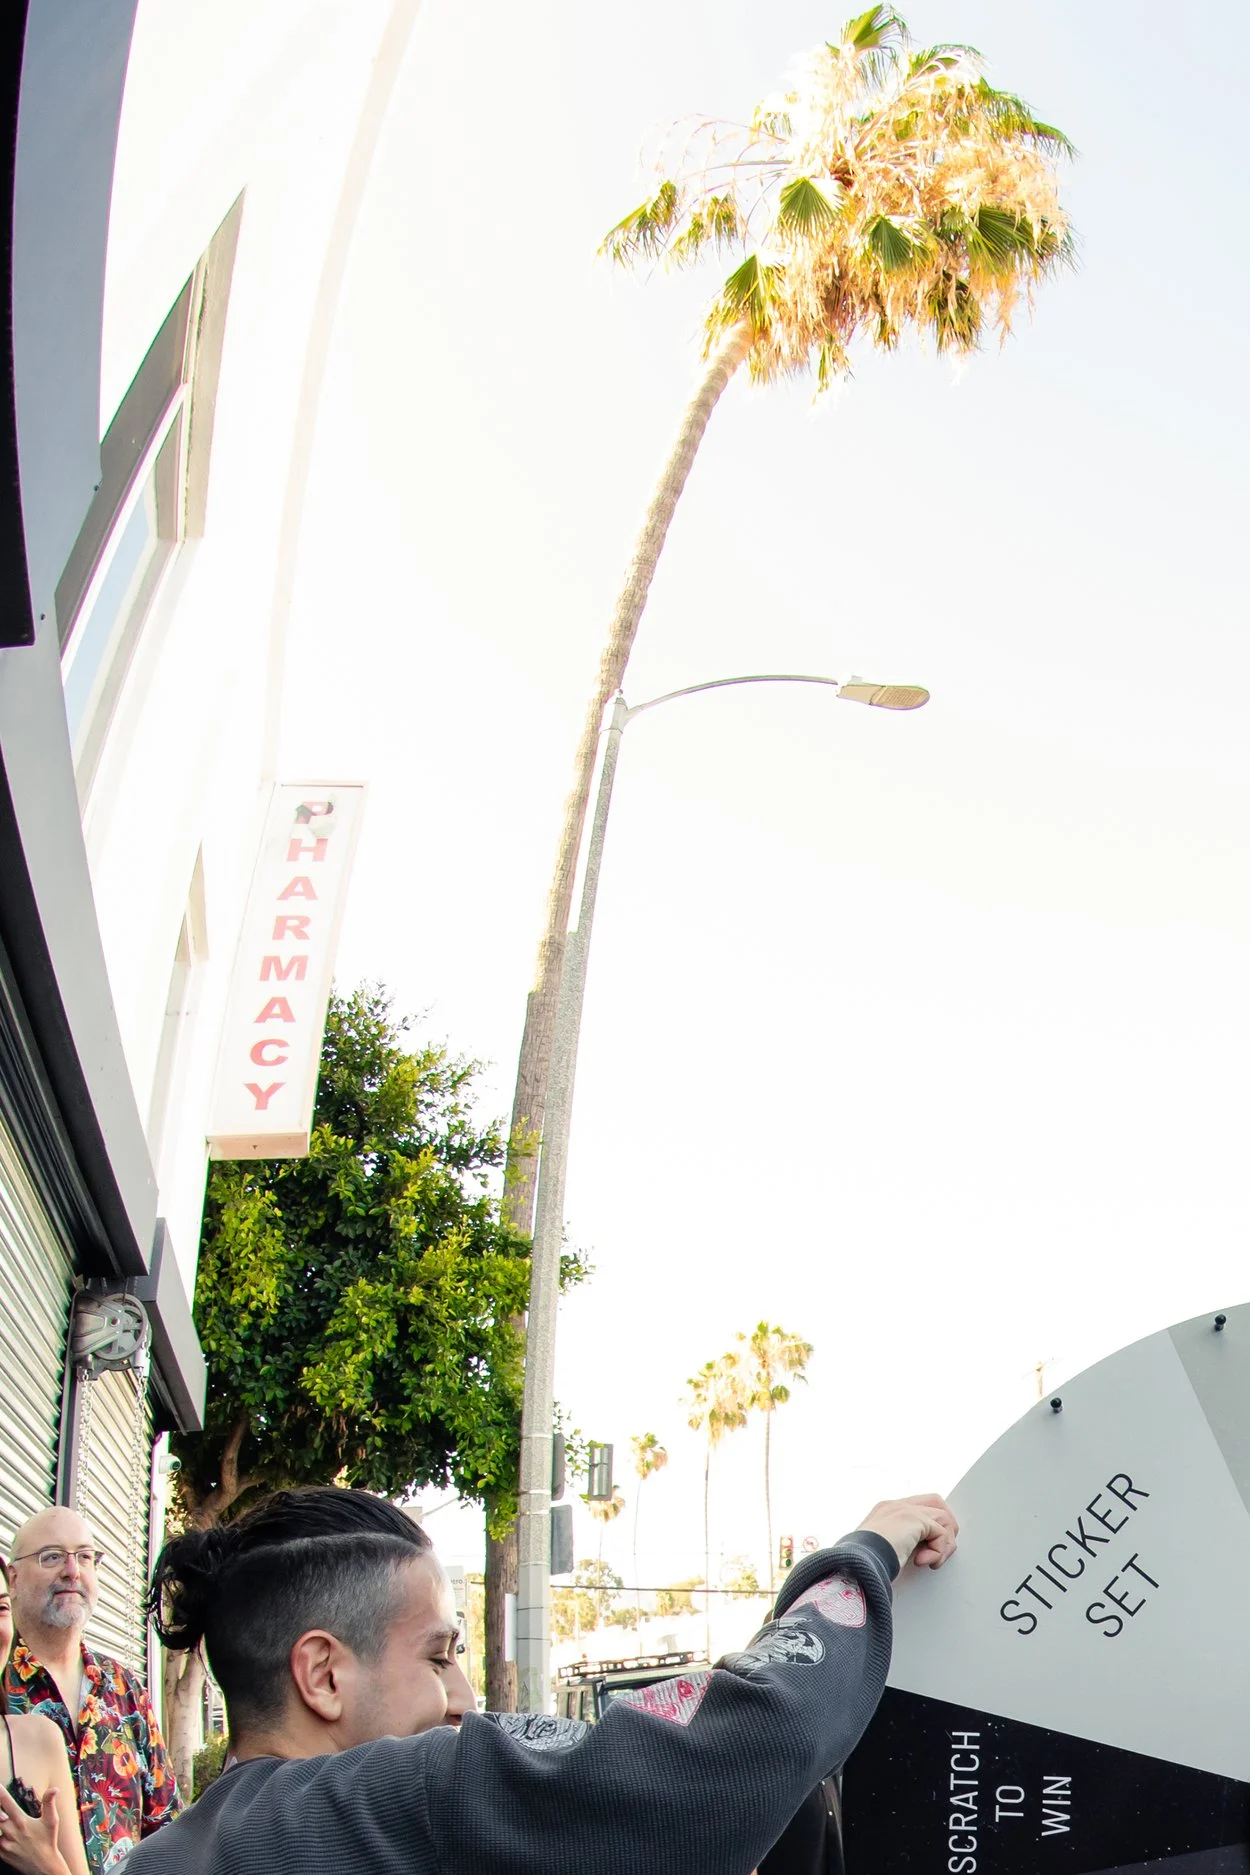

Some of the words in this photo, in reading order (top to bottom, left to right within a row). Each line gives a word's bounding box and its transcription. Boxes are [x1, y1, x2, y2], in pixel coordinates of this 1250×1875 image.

[243, 801, 335, 1110] PHARMACY
[1000, 1473, 1150, 1635] STICKER
[1086, 1553, 1160, 1637] SET
[947, 1731, 981, 1874] SCRATCH
[995, 1785, 1025, 1823] TO
[1041, 1775, 1072, 1837] WIN
